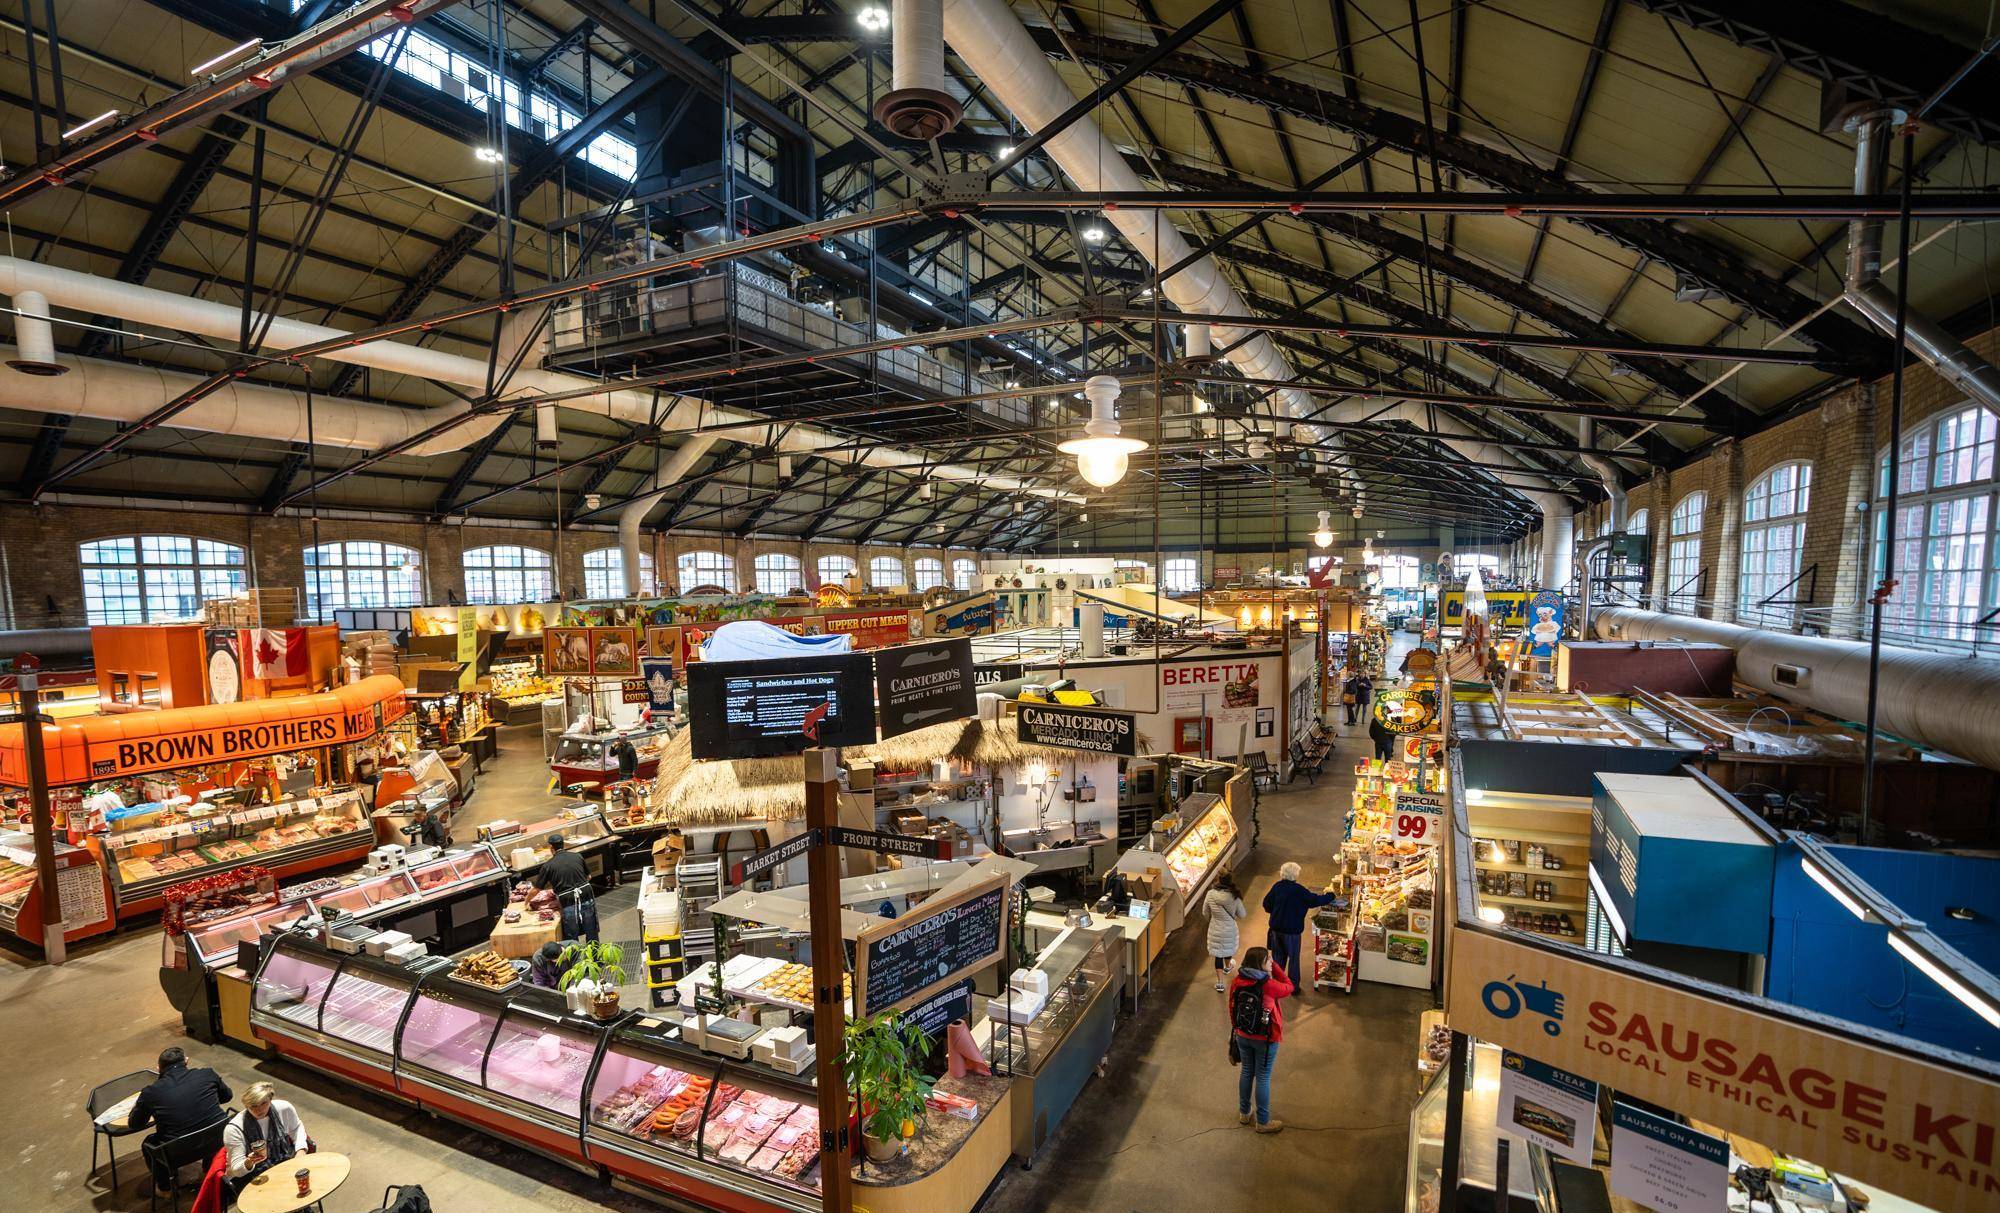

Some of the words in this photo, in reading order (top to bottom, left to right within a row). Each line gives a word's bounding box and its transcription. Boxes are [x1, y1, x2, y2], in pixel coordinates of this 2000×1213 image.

[827, 618, 859, 632] UPPER
[861, 616, 879, 628] CUT
[879, 614, 907, 626] MEATS
[756, 680, 792, 688] Sandwiches
[890, 668, 961, 693] CARNICERO'S
[1163, 664, 1259, 685] BERETTA
[890, 695, 906, 705] PRIME
[908, 692, 924, 702] MEATS
[932, 688, 943, 696] FINE
[945, 682, 962, 692] FOODS
[1380, 690, 1422, 702] CAROUSEL
[1023, 708, 1129, 734] CARNICERO'S
[1383, 721, 1421, 733] BAKERY
[119, 733, 213, 768] BROWN
[223, 718, 337, 753] BROTHERS
[343, 708, 374, 736] MEATS
[1031, 725, 1079, 739] MERCADO
[1083, 731, 1119, 744] LUNCH
[1036, 735, 1112, 751] www.carnicero's.ca
[93, 765, 116, 776] 1895
[56, 800, 82, 811] Bacon
[1397, 795, 1443, 807] SPECIAL
[1397, 803, 1443, 815] RAISINS
[1398, 814, 1426, 839] 99
[842, 832, 877, 846] FRONT
[881, 839, 923, 853] STREET
[746, 851, 780, 875] MARKET
[781, 836, 810, 858] STREET
[916, 1001, 934, 1019] YOUR
[933, 991, 953, 1009] ORDER
[953, 986, 969, 999] HERE
[1586, 1000, 1887, 1130] SAUSAGE
[1552, 1070, 1586, 1090] STEAK
[1584, 1035, 1667, 1076] LOCAL
[1687, 1071, 1818, 1131] ETHICAL
[1620, 1113, 1666, 1136] SAUSAGE
[1669, 1131, 1685, 1143] ON
[1688, 1139, 1696, 1147] A
[1699, 1141, 1722, 1156] BUN
